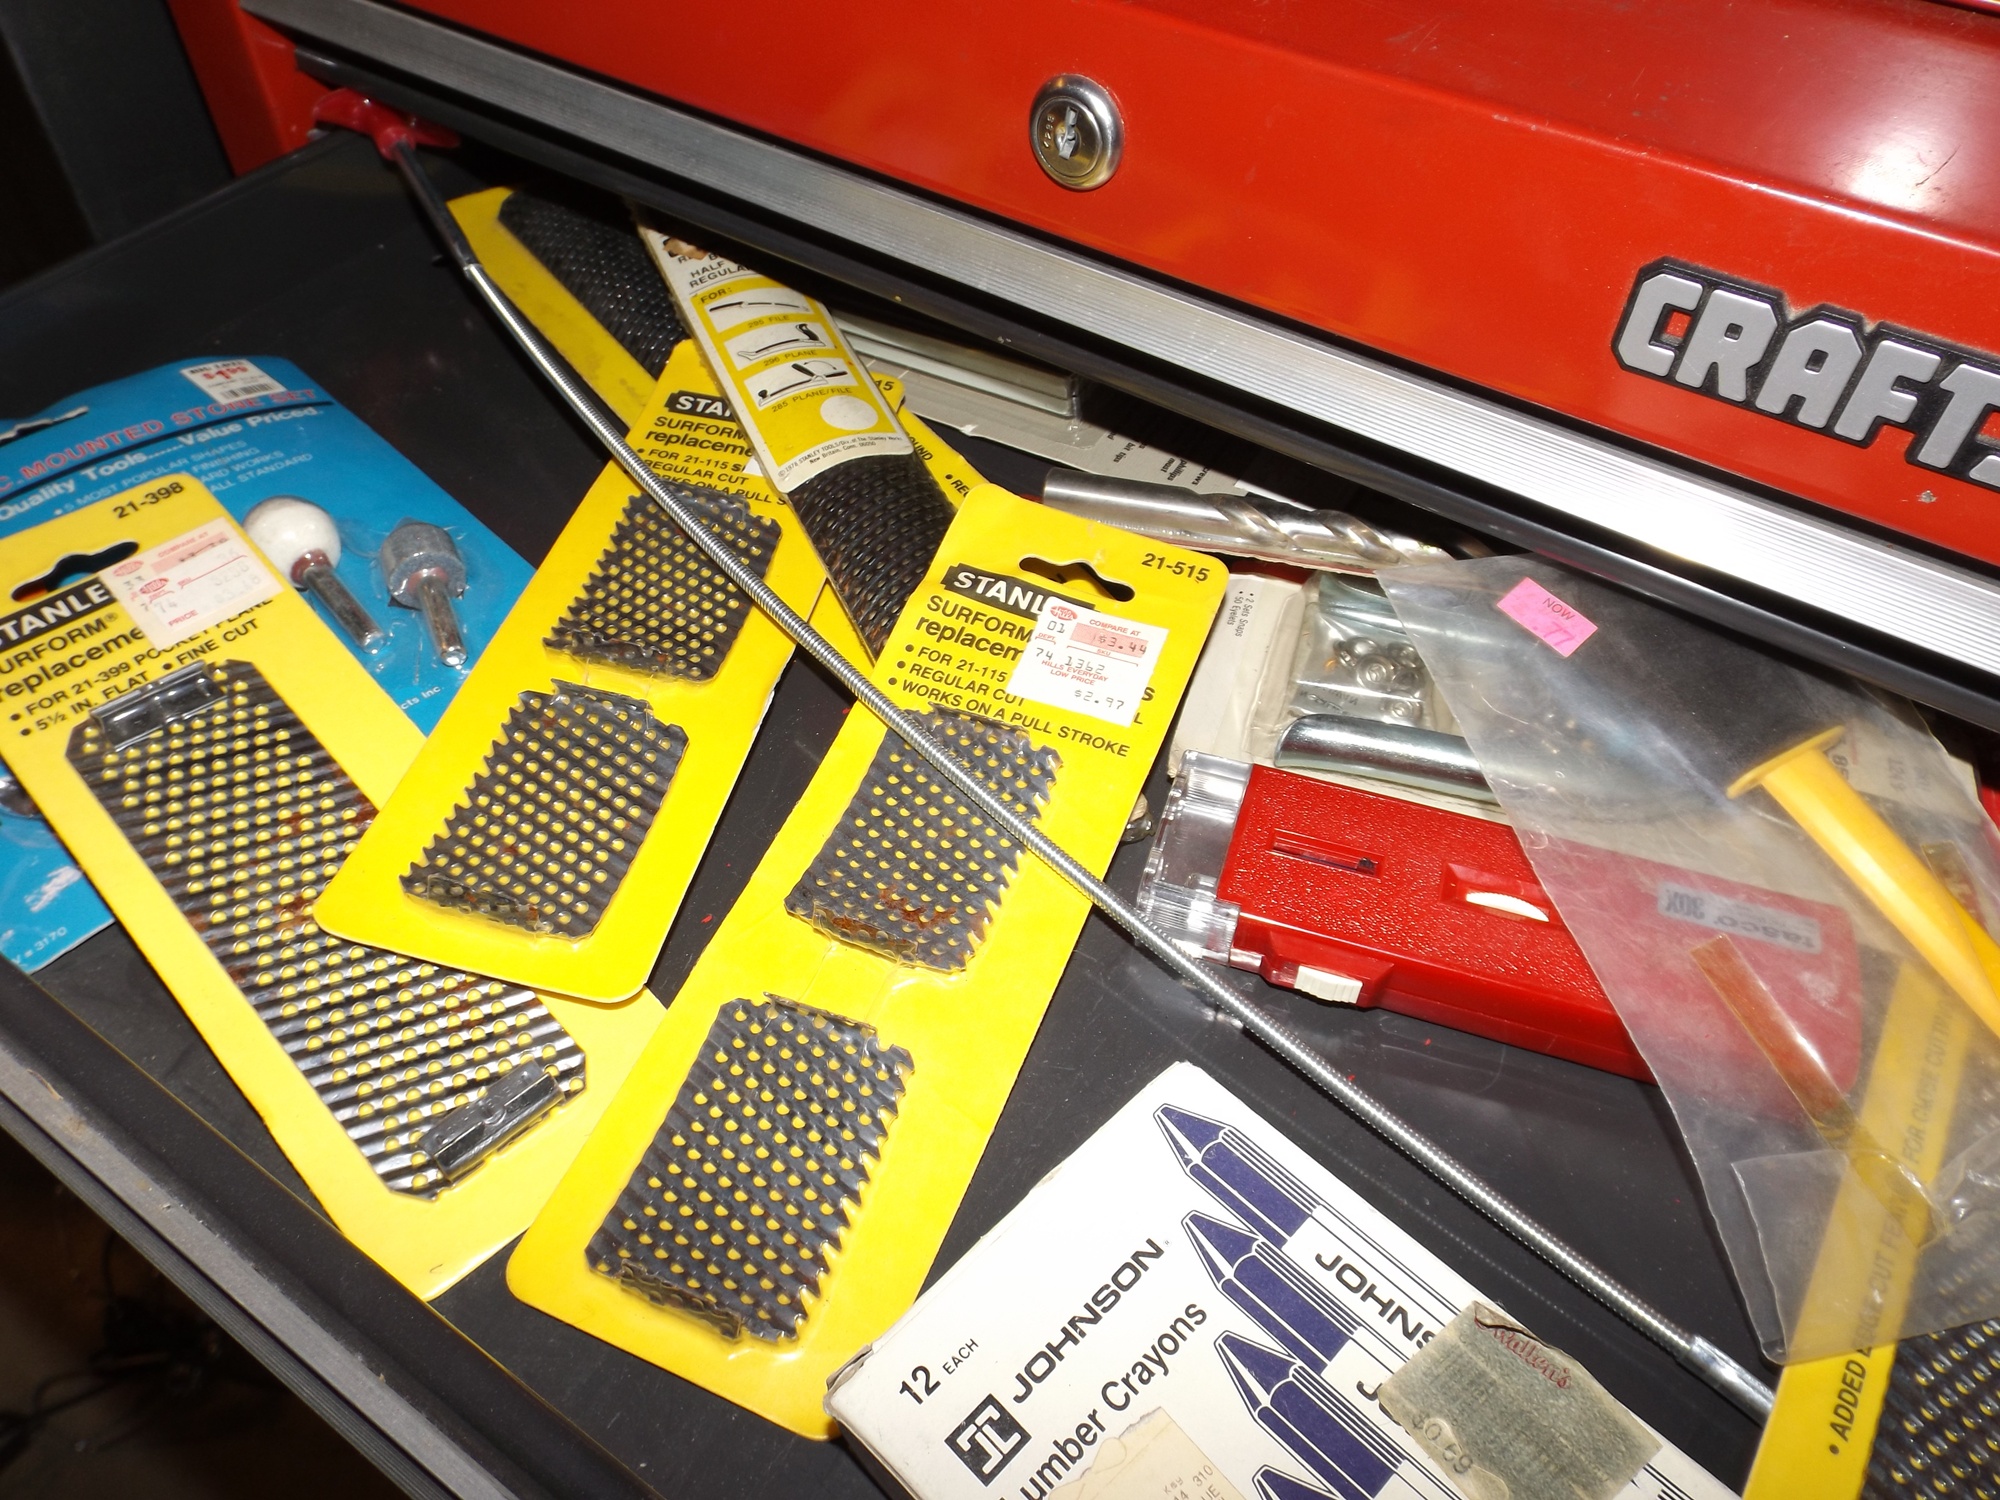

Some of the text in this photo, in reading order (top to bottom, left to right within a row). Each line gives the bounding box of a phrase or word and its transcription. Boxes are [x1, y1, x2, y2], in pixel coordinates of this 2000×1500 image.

[688, 263, 752, 289] REGULA
[690, 261, 726, 278] HALF
[700, 286, 734, 304] FOR:
[769, 314, 791, 323] FILE
[784, 350, 818, 360] PLANE
[1617, 272, 2000, 488] CRAFT
[771, 387, 853, 413] 285 PLANE/FILE
[20, 419, 164, 480] MOUNTED
[171, 397, 265, 426] STONE
[269, 388, 316, 404] SET
[192, 446, 261, 473] FINISHING
[233, 450, 285, 472] WORKS
[648, 448, 680, 461] FOR
[683, 454, 729, 471] 21-115
[799, 449, 821, 464] STANLEY
[809, 456, 821, 465] New
[908, 436, 934, 462] OUND
[76, 483, 118, 505] MOST
[121, 457, 189, 487] POPULAR
[190, 440, 248, 461] SHAPES
[237, 452, 313, 483] STANDARD
[717, 473, 749, 486] CUT
[0, 478, 75, 520] Quality
[112, 481, 185, 519] 21-398
[1140, 552, 1212, 583] 21-515
[0, 582, 111, 646] TANLE
[168, 609, 199, 627] PRICE
[927, 595, 1035, 643] SURFORM
[1542, 597, 1575, 620] NOW
[1089, 619, 1142, 637] COMPARE AT
[177, 618, 260, 667] FINE CUT
[1099, 634, 1148, 655] $3.44
[917, 646, 1009, 683] FOR 21-115
[1035, 647, 1106, 675] 74 1362
[1042, 659, 1109, 682] HILLS EVERYDAY
[25, 689, 68, 716] FOR
[70, 661, 131, 695] 21-399
[102, 669, 150, 700] FLAT
[909, 663, 990, 696] REGULAR
[1050, 669, 1096, 686] LOW PRICE
[1074, 689, 1125, 710] $2.97
[902, 679, 1131, 758] WORKS ON A PULL STROKE
[1713, 914, 1816, 949] tasco
[1829, 1358, 1866, 1442] ADDED
[1868, 1250, 1896, 1294] CUT
[1902, 1125, 1927, 1165] FOR
[1012, 1237, 1165, 1404] JOHNSON
[899, 1338, 980, 1405] 12 EACH
[1002, 1303, 1208, 1500] umber Crayons
[1192, 1464, 1214, 1487] 310
